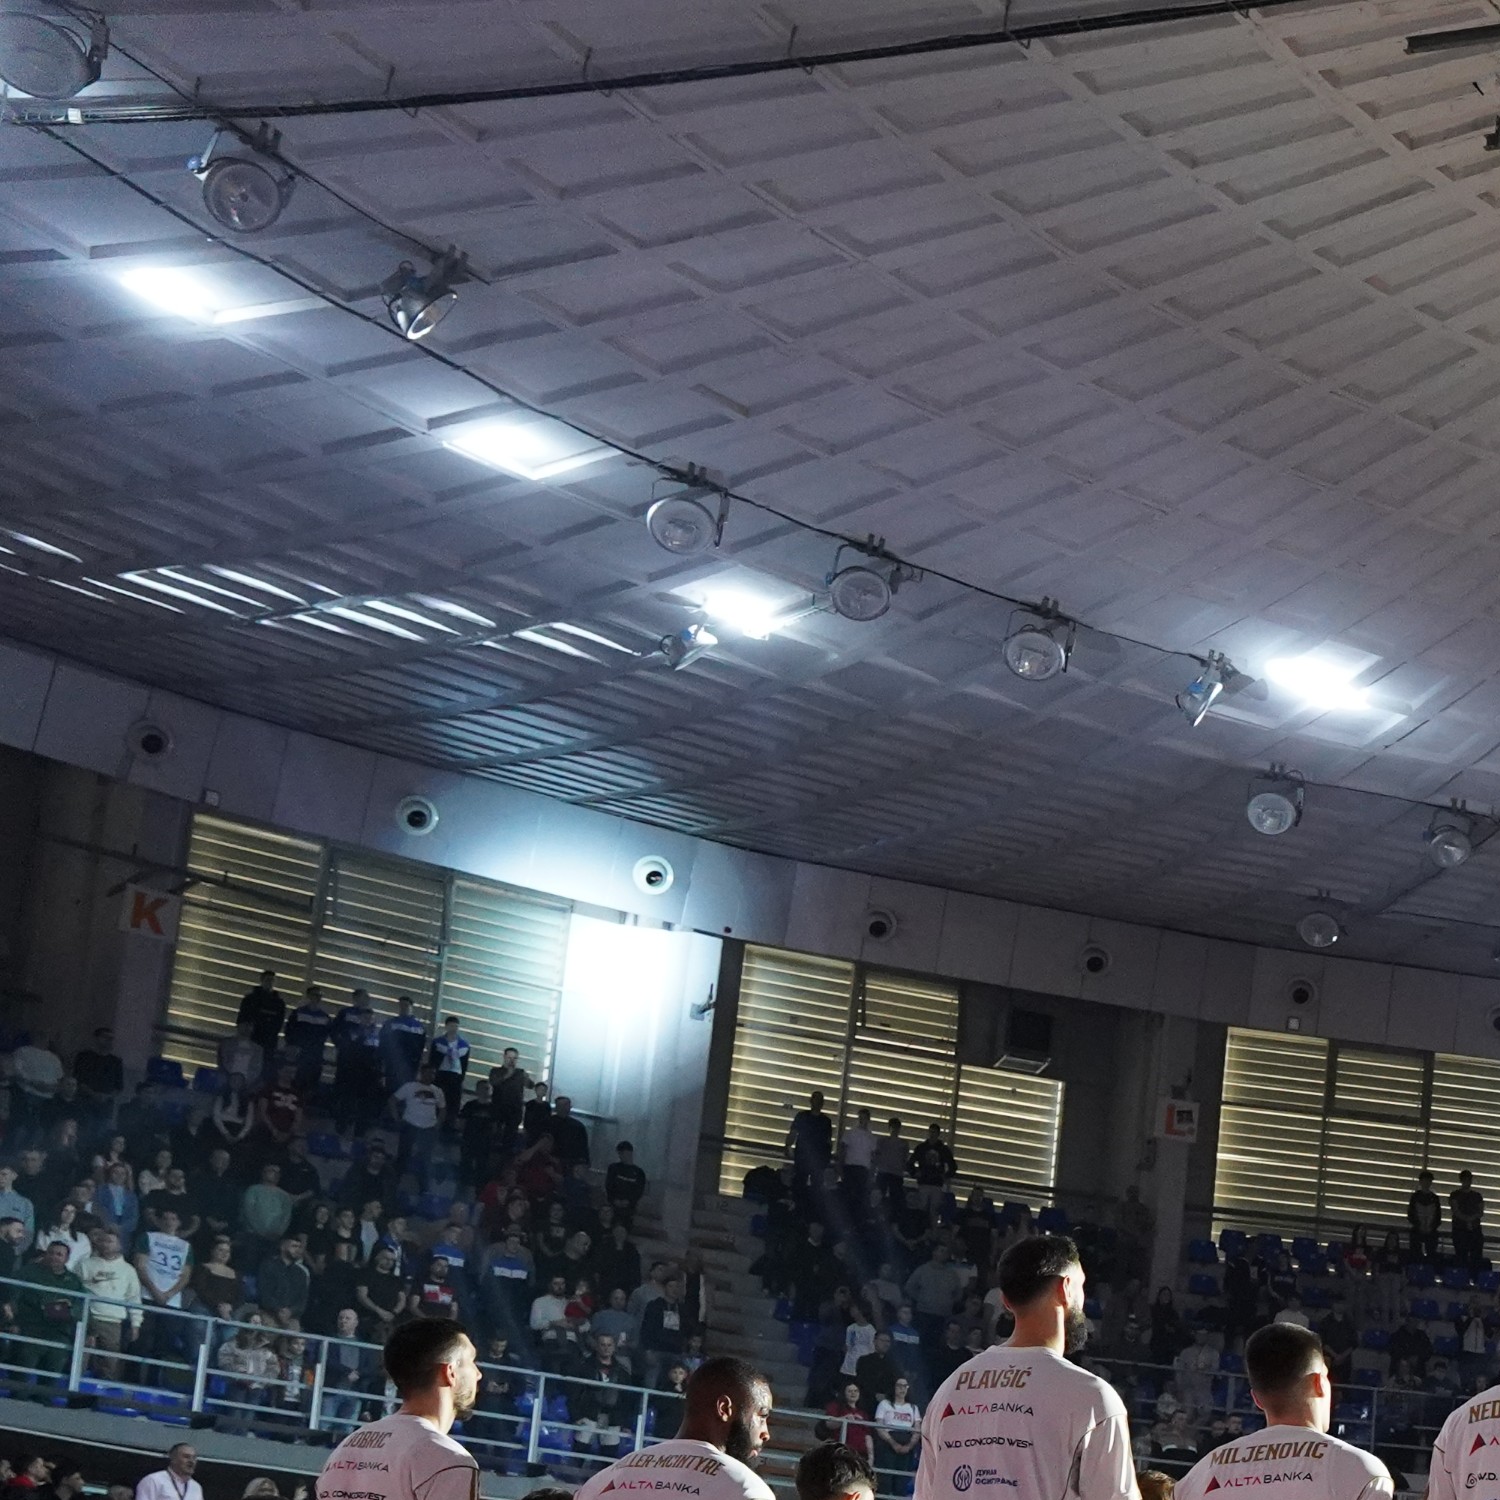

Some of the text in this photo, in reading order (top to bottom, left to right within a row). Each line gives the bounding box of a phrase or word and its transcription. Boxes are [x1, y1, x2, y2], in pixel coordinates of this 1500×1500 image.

[130, 891, 167, 936] K
[152, 1252, 181, 1271] 33
[956, 1365, 1032, 1390] PLAVŠIĆ
